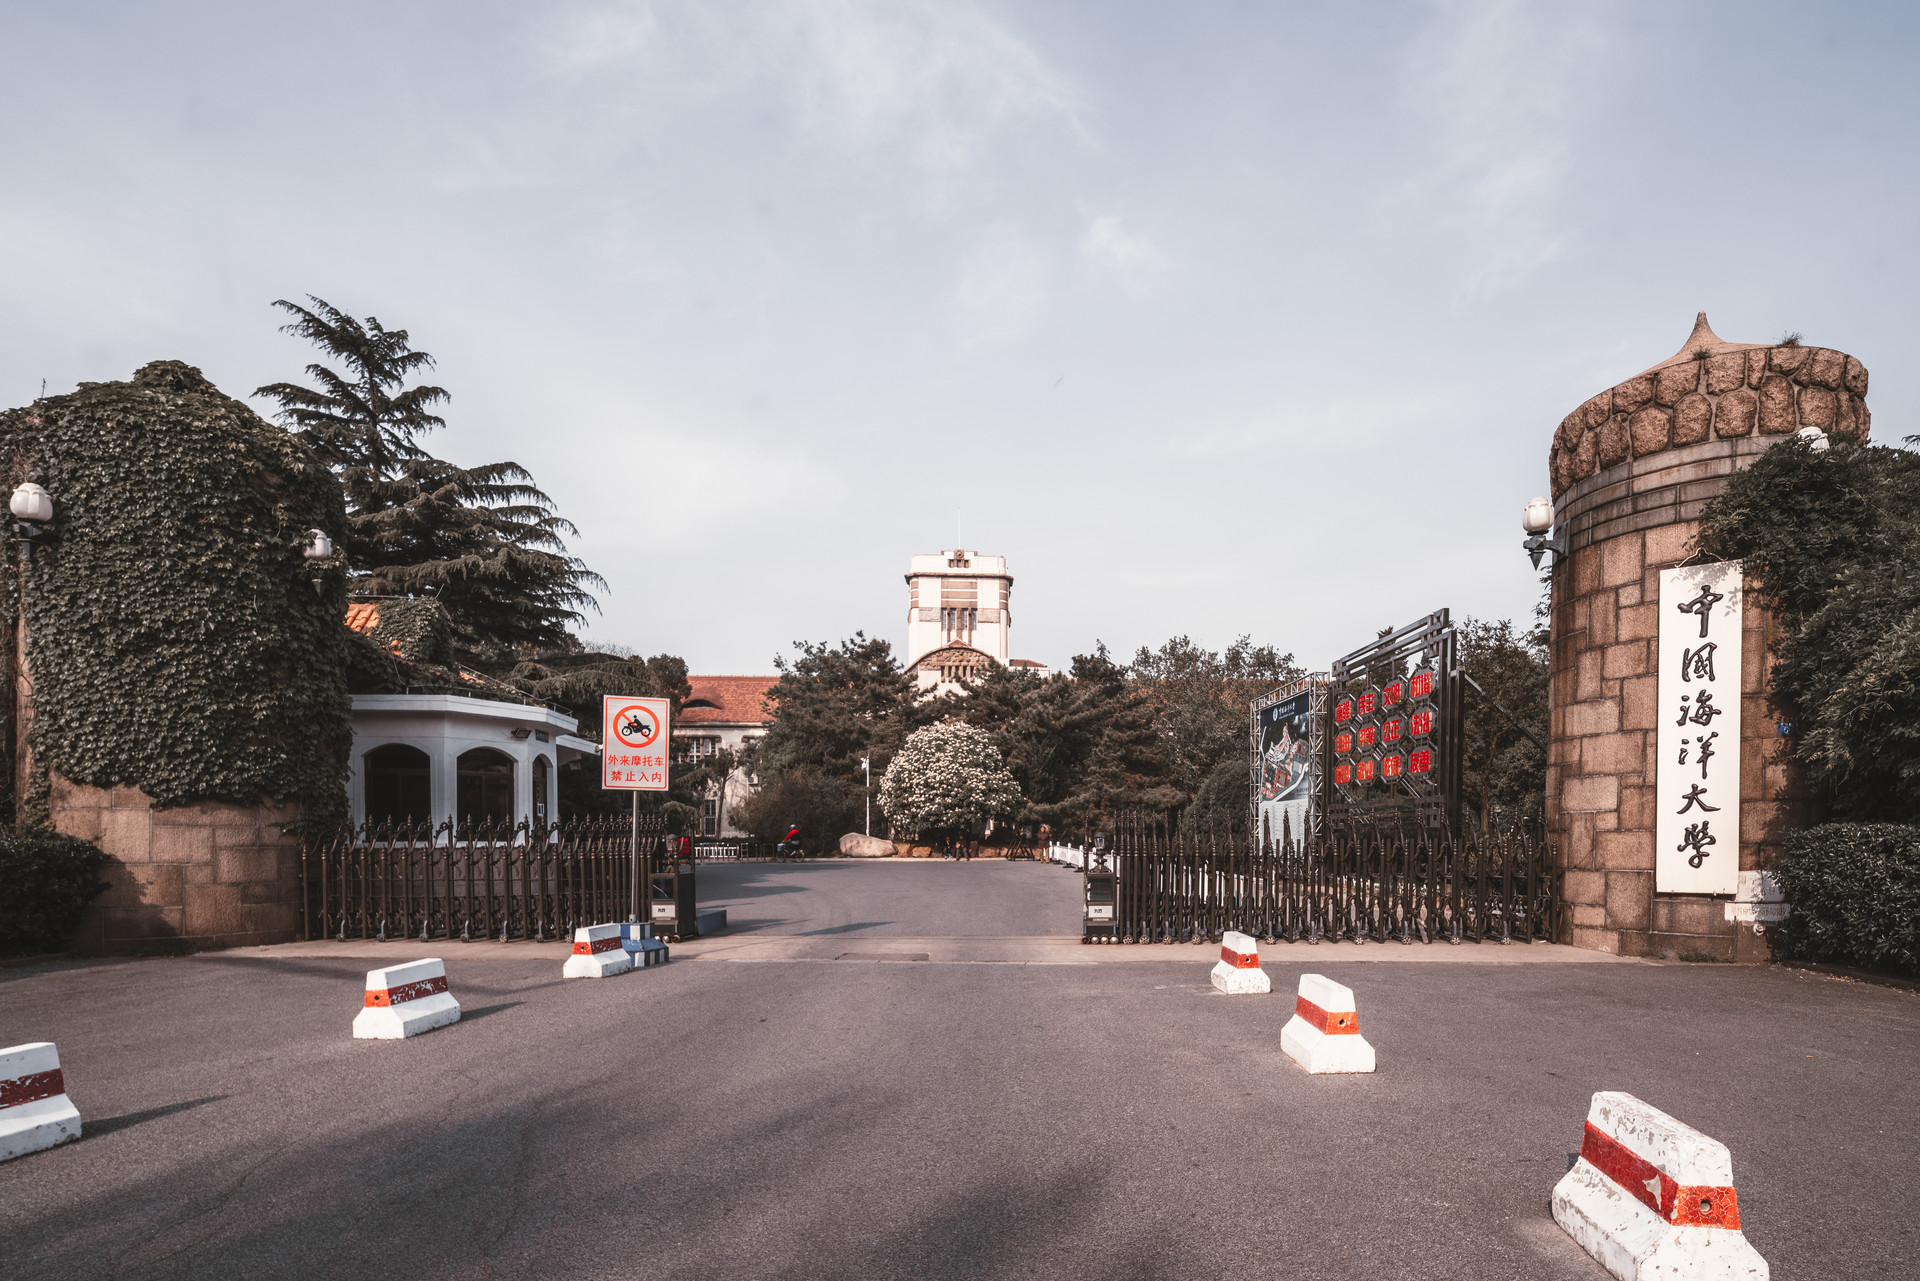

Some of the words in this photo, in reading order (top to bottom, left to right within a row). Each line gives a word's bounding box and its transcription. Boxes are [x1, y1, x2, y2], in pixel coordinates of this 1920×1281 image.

[1358, 692, 1375, 715] 民主
[1383, 682, 1401, 707] 文明
[1410, 671, 1432, 698] 和谐
[1336, 733, 1352, 753] 自由
[1358, 725, 1375, 747] 平等
[1383, 718, 1401, 742] 公正
[1410, 711, 1432, 736] 法治
[608, 754, 664, 768] 外来摩托车
[1410, 749, 1431, 773] 友善
[611, 770, 662, 783] 禁止入内
